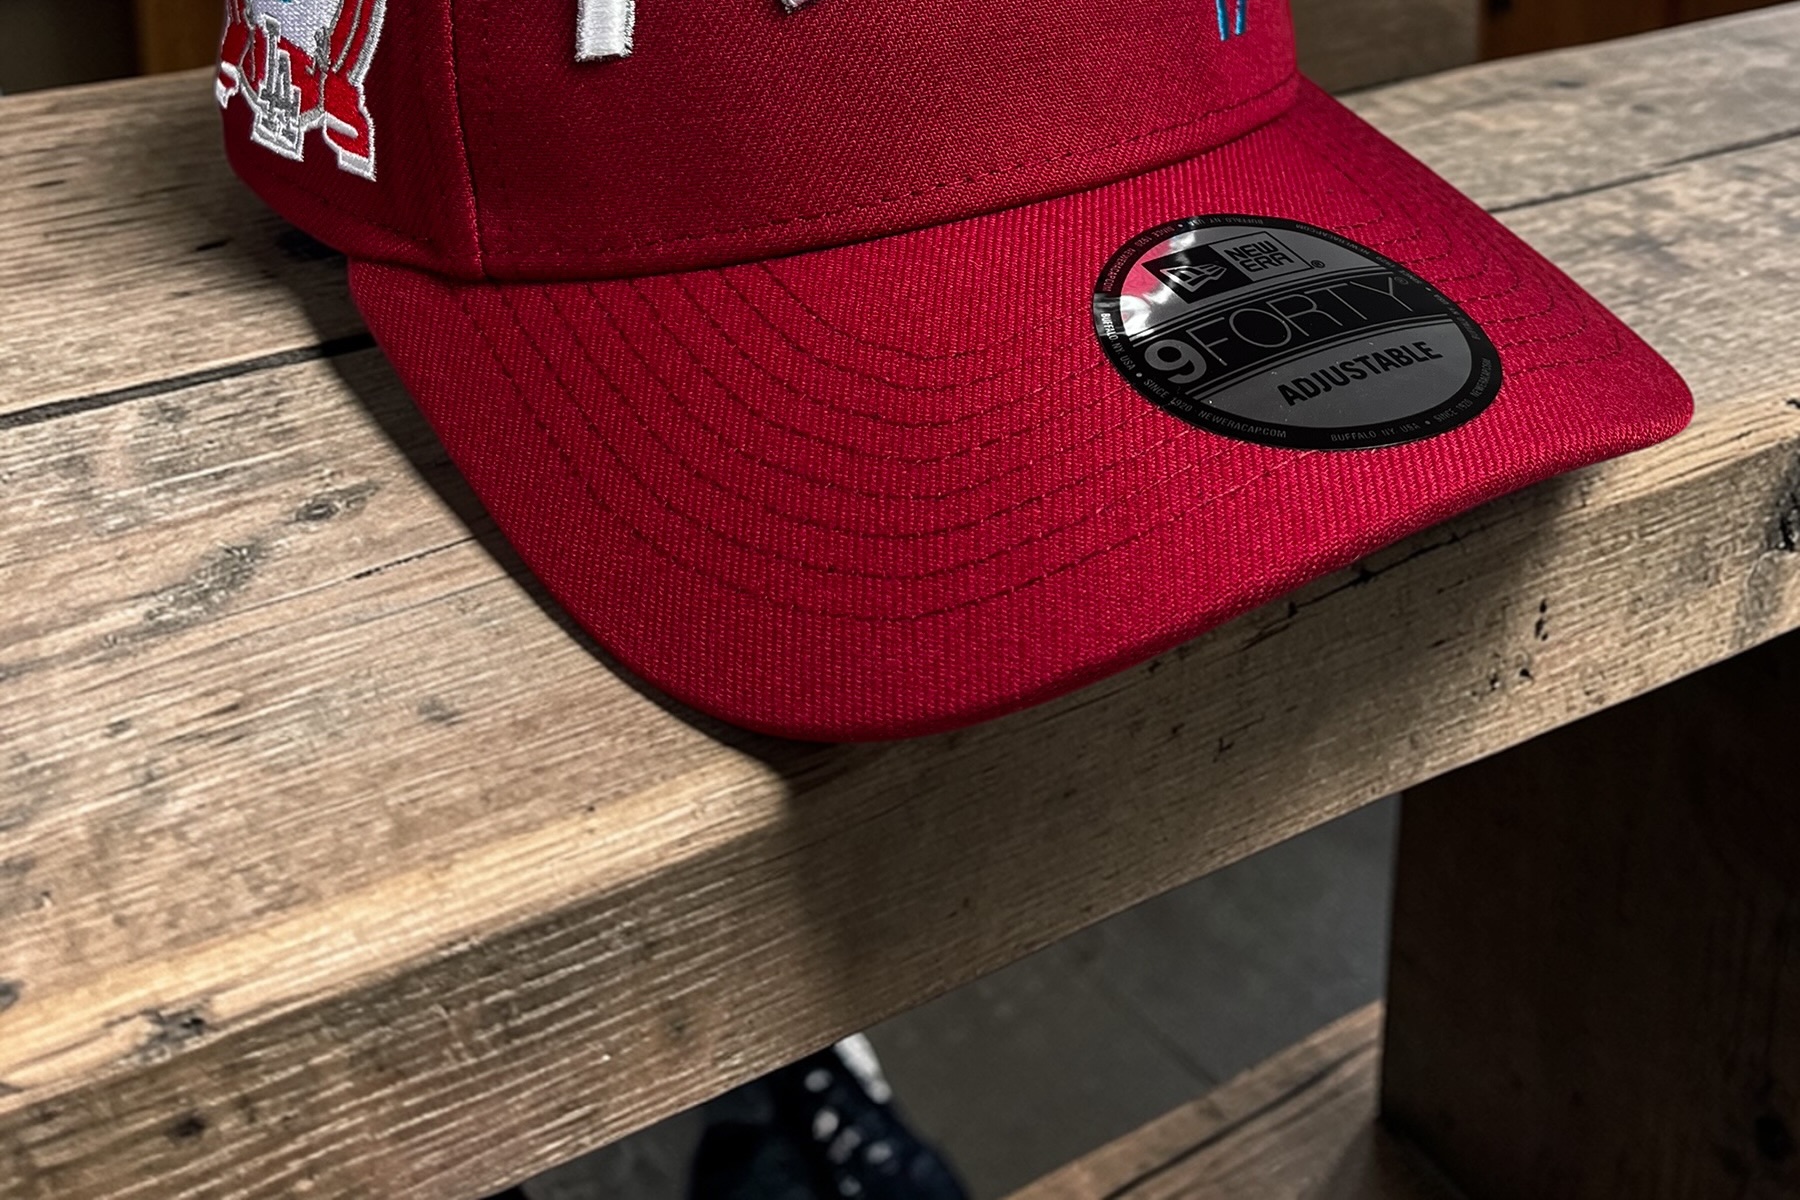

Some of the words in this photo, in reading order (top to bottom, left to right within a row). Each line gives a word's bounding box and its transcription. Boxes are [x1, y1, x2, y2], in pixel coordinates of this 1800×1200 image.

[1223, 240, 1279, 262] NEW
[1239, 252, 1294, 273] ERA
[1121, 352, 1136, 371] USA
[1144, 378, 1169, 399] SINCE
[1170, 397, 1193, 413] 1920
[1276, 341, 1444, 408] ADJUSTABLE
[1400, 422, 1422, 434] USA
[1433, 408, 1459, 423] SINCE
